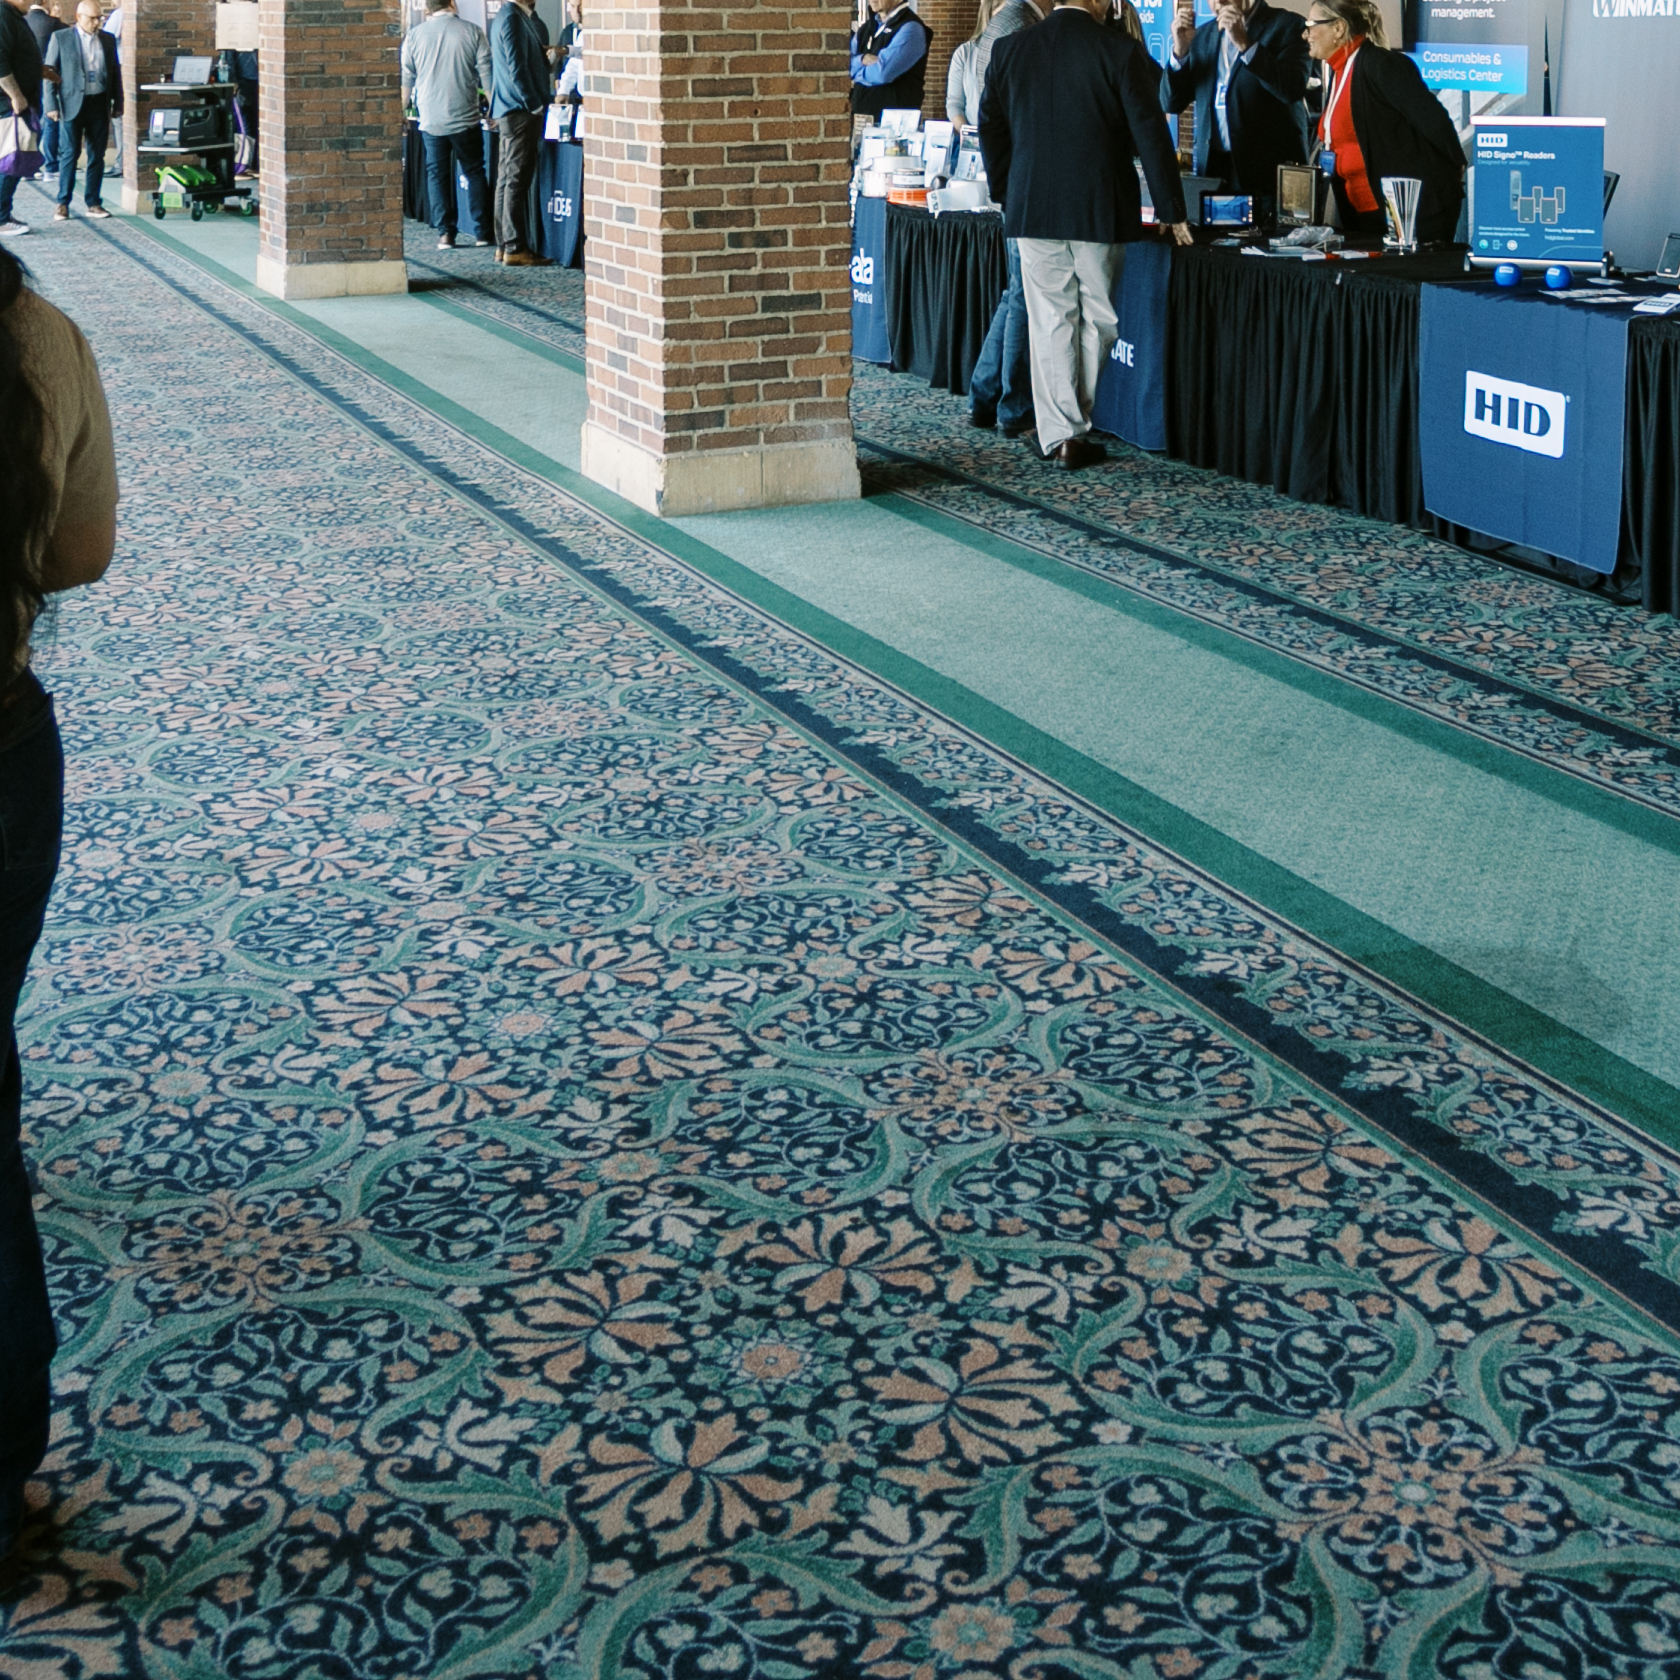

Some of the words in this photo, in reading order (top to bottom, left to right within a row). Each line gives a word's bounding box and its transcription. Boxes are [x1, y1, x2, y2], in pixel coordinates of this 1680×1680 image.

[1431, 7, 1495, 20] management.
[1423, 50, 1492, 65] Consumables
[1493, 52, 1502, 66] &
[1421, 67, 1467, 81] Logistics
[1468, 69, 1503, 82] Center
[1477, 151, 1493, 159] HID
[1523, 151, 1556, 160] Readers
[1474, 387, 1551, 438] HID
